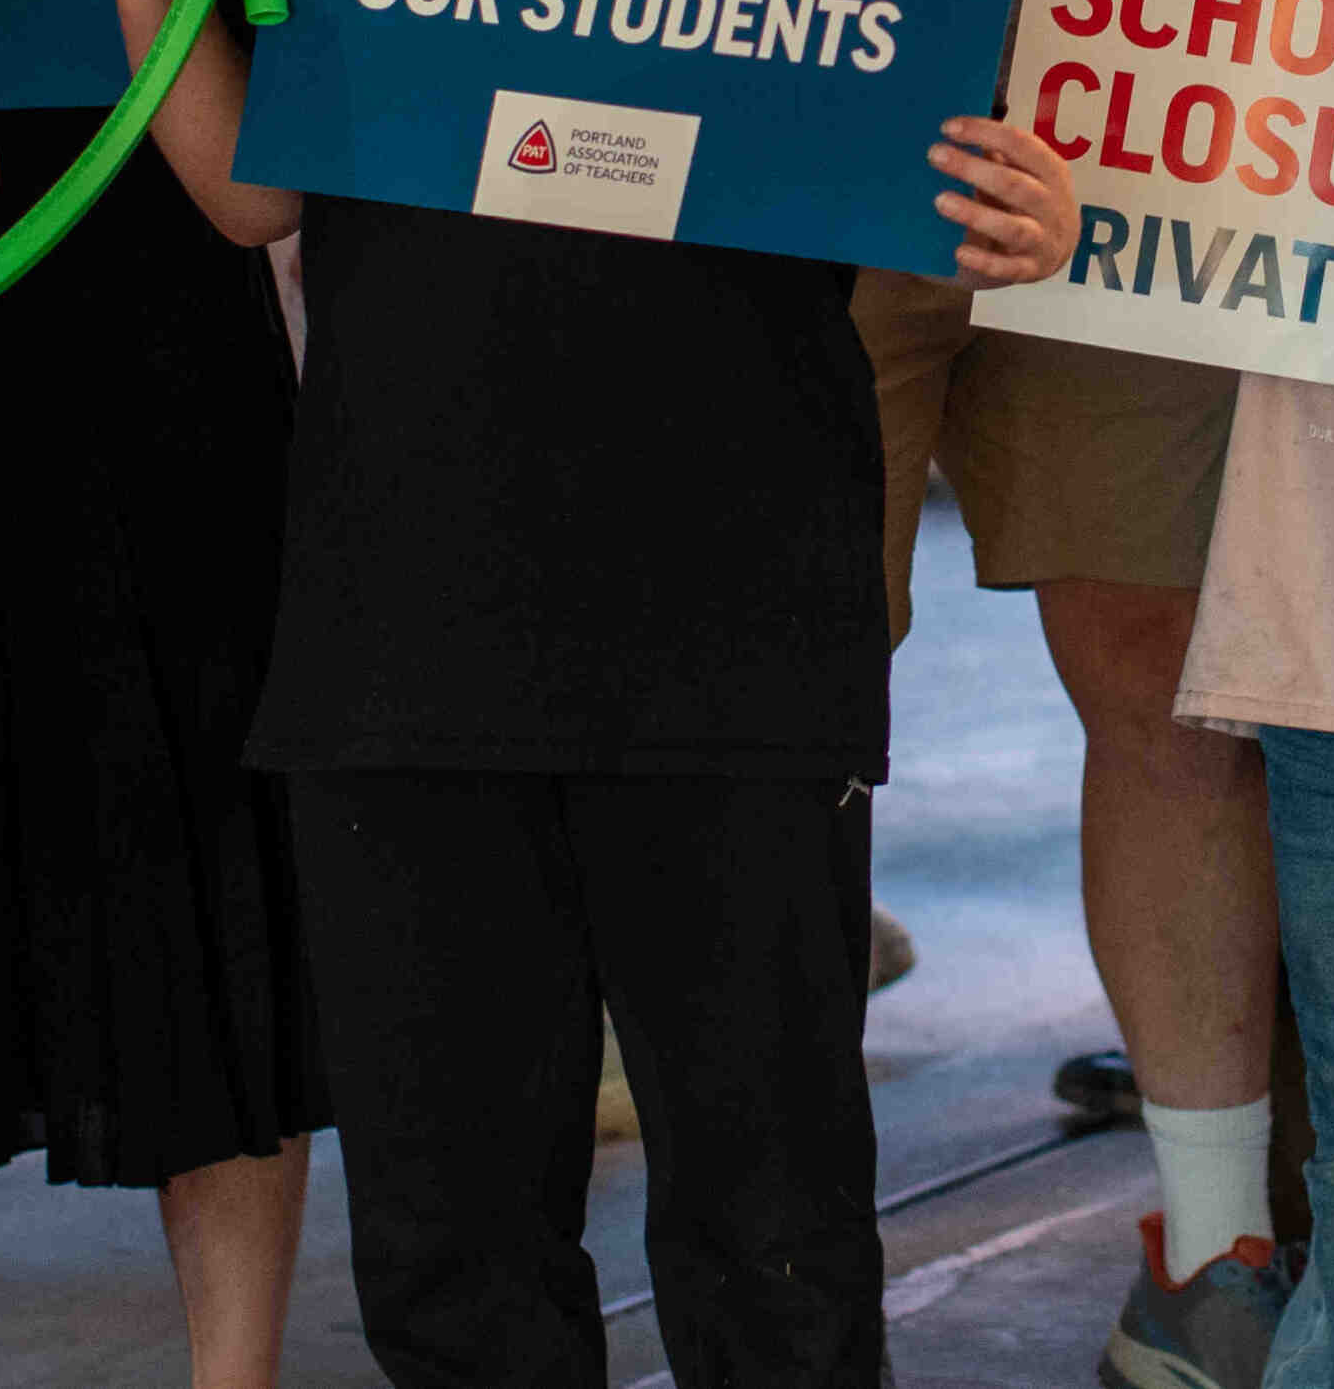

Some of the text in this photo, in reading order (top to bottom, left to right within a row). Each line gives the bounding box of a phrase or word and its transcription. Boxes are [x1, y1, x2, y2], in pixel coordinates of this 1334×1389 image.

[570, 128, 646, 150] PORTLAND
[522, 145, 548, 159] PAT
[566, 146, 659, 169] ASSOCIATION
[563, 162, 655, 185] OF TEACHERS
